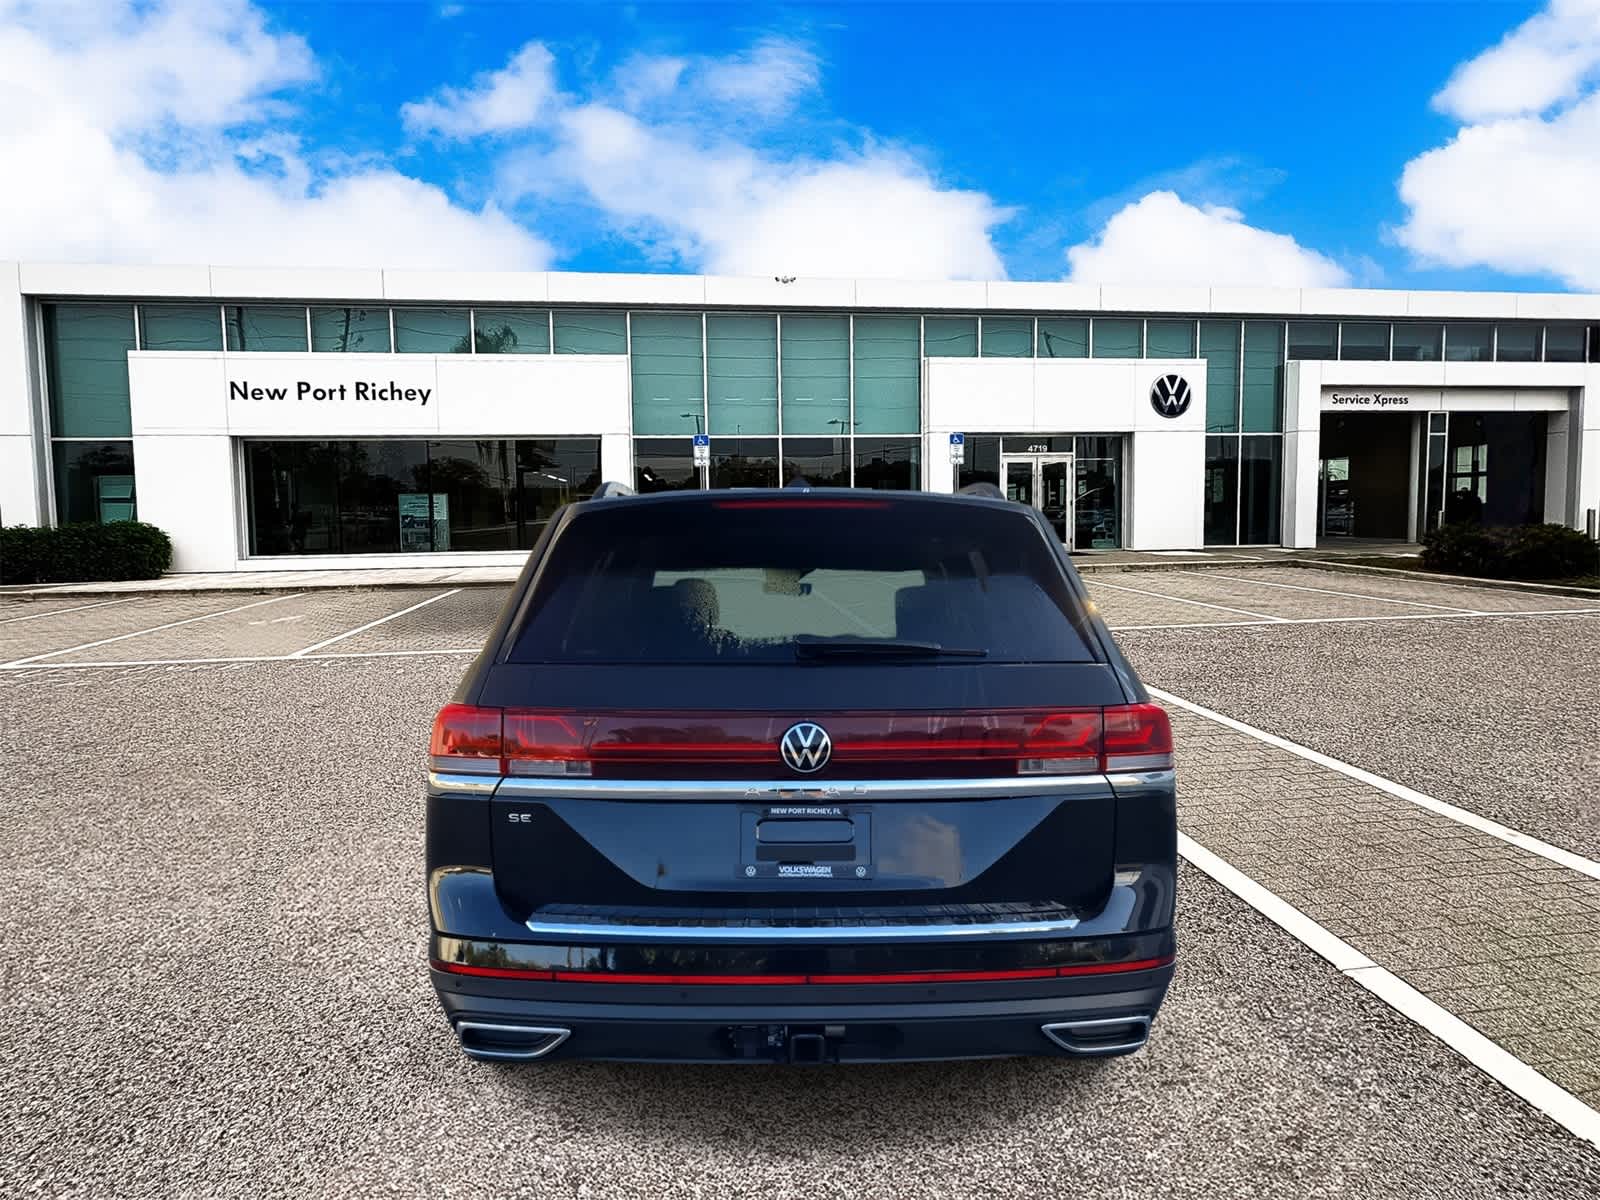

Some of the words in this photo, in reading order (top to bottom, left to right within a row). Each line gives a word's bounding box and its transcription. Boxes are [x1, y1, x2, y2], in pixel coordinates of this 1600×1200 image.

[229, 381, 288, 400] New
[297, 381, 347, 400] Port
[355, 381, 432, 406] Richey
[1332, 393, 1370, 404] Service
[1373, 393, 1409, 407] Xpress
[1027, 444, 1048, 452] 4719
[807, 807, 833, 815] RICHEY,
[508, 813, 532, 823] SE
[779, 865, 832, 873] VOLKSWAGEN
